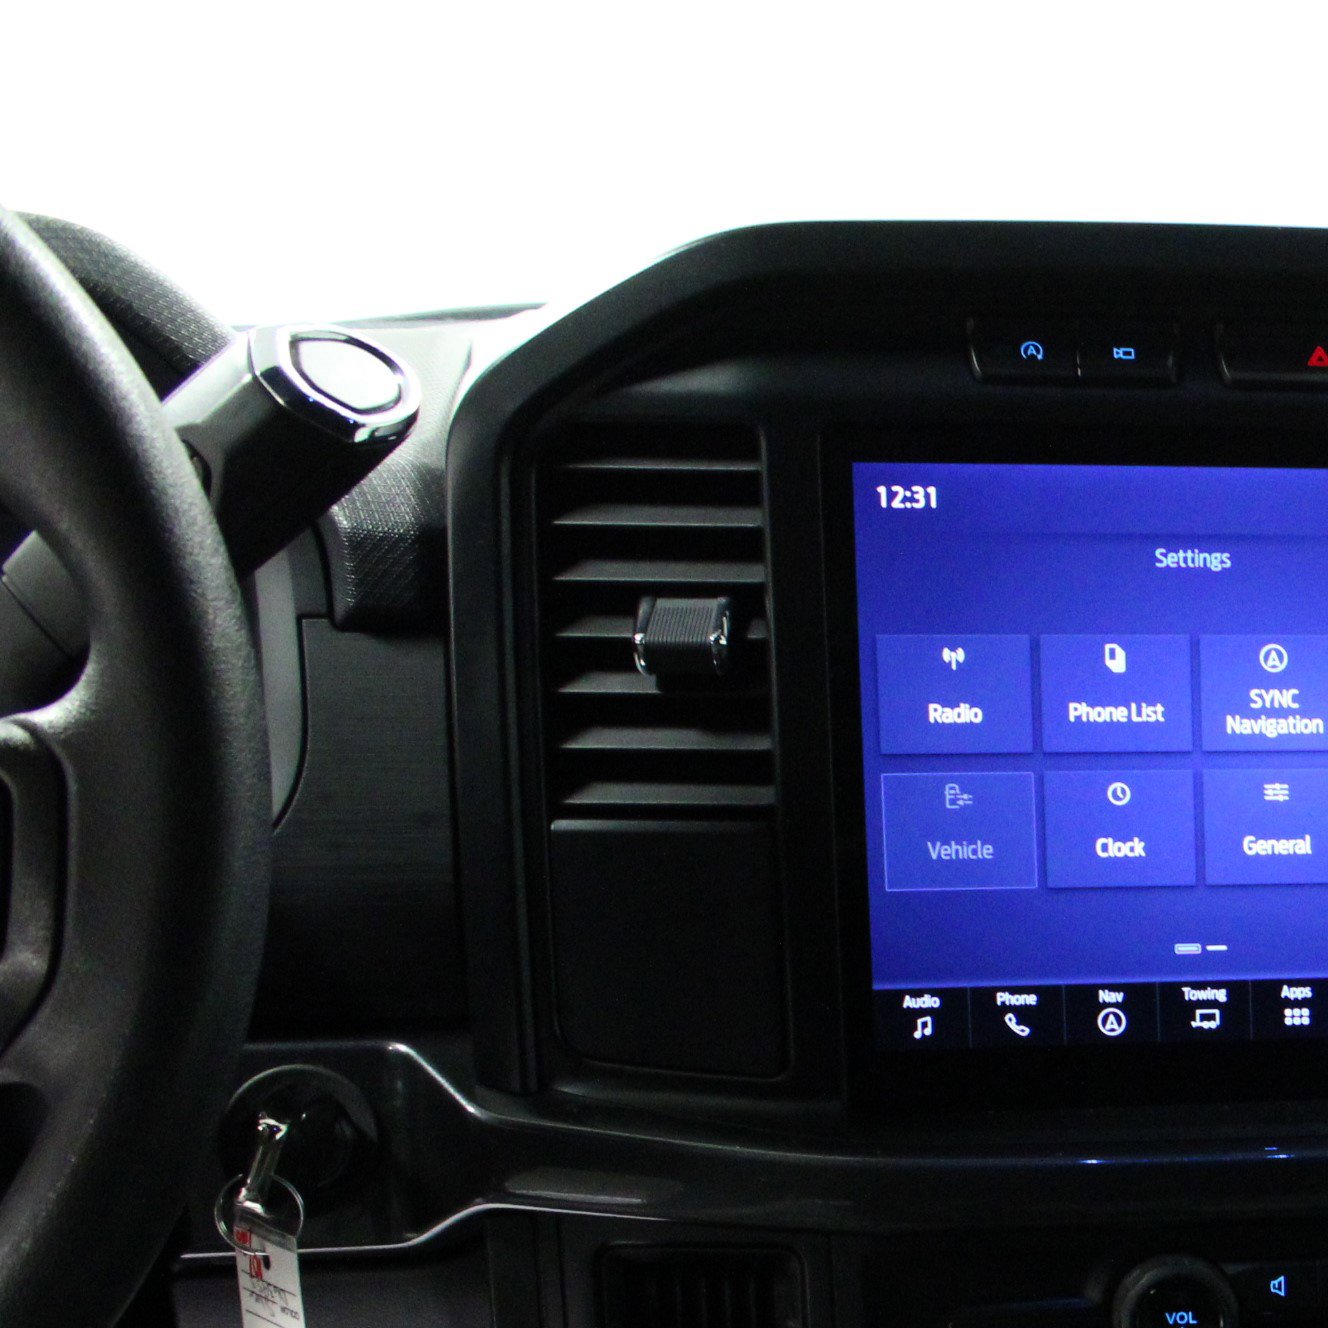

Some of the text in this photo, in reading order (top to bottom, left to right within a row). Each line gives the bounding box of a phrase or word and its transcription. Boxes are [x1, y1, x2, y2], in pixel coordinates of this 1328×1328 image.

[876, 485, 937, 509] 12:31
[1155, 549, 1231, 571] Settings
[1249, 690, 1299, 709] SYNC
[928, 704, 982, 724] Radio
[1068, 702, 1165, 722] Phone List
[1226, 715, 1324, 737] Navigation
[927, 840, 993, 861] Vehicle
[1096, 837, 1145, 858] Clock
[1243, 835, 1312, 855] General
[903, 994, 940, 1009] Audio
[996, 991, 1037, 1006] Phone
[1099, 990, 1124, 1004] Nav
[1182, 987, 1227, 1003] Towing
[1281, 986, 1312, 1000] Apps
[1165, 1311, 1197, 1325] VOL
